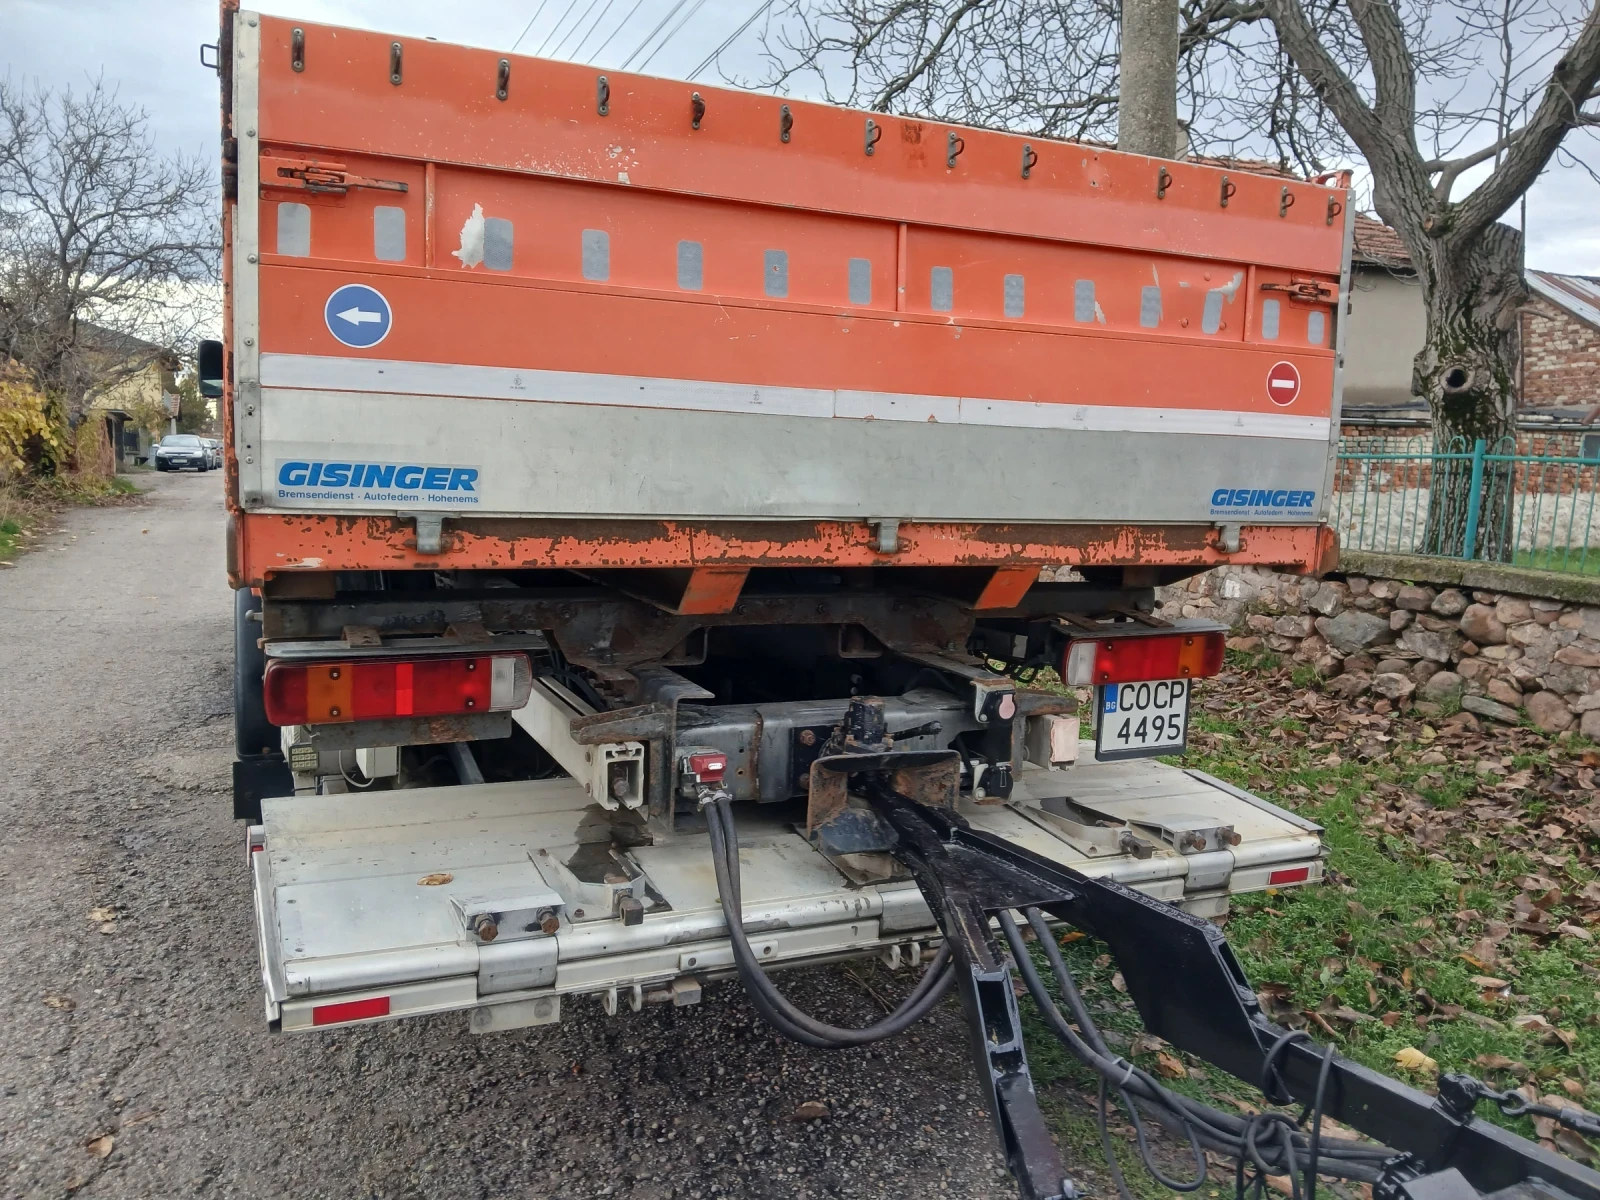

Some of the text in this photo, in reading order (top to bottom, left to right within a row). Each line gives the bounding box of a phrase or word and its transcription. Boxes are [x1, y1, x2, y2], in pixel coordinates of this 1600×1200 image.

[278, 462, 478, 491] GISINGER
[278, 489, 479, 503] Bremsendienst Autofedern Hohenems
[1211, 488, 1316, 507] GISINGER
[1105, 701, 1116, 710] BG
[1117, 713, 1181, 745] 4495
